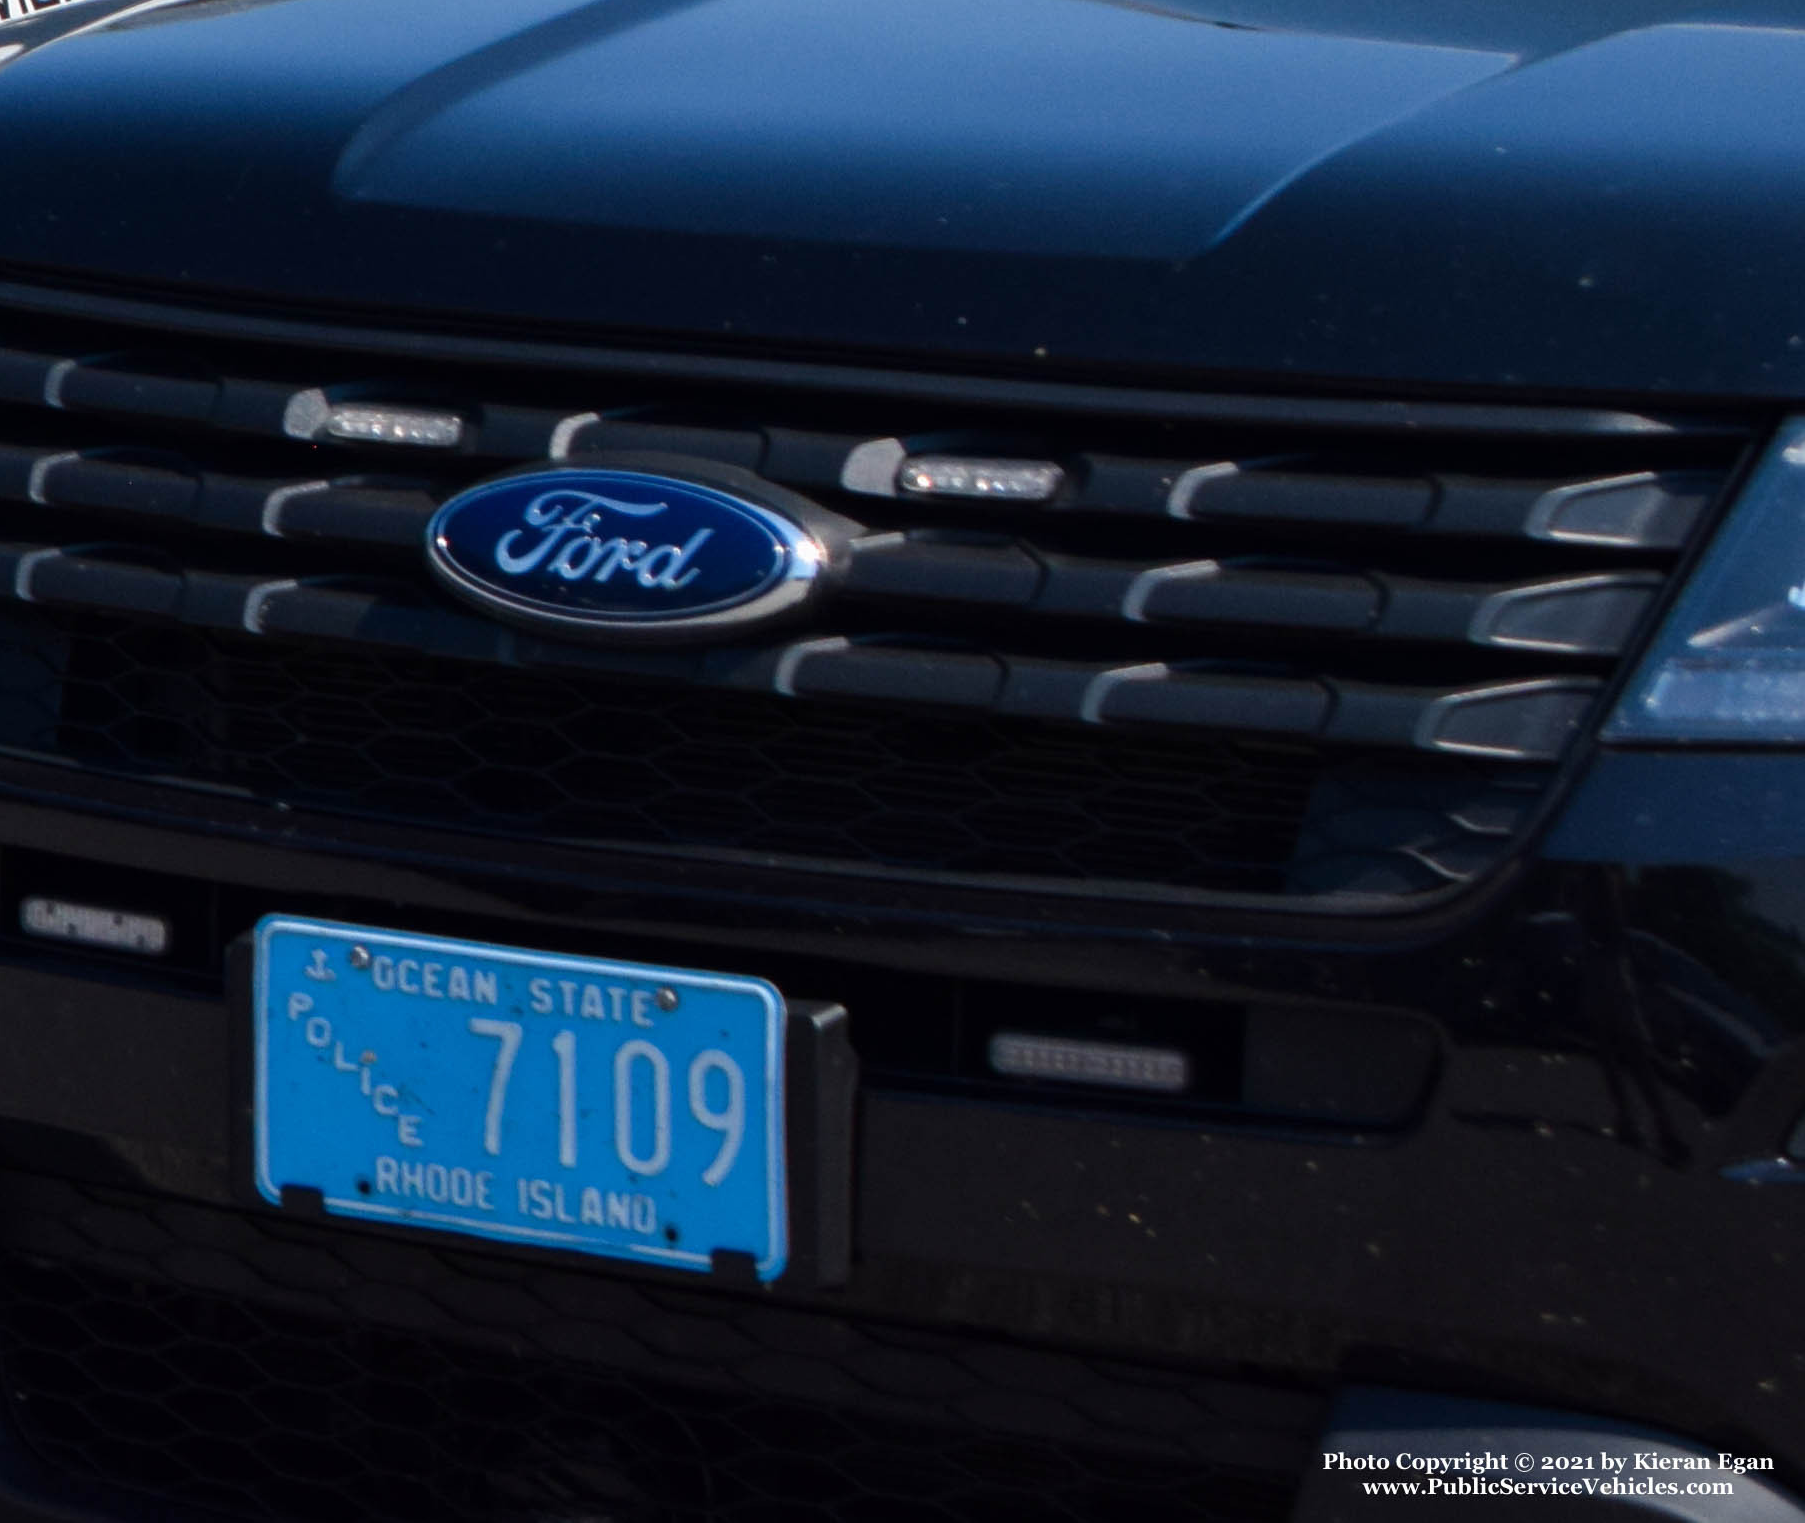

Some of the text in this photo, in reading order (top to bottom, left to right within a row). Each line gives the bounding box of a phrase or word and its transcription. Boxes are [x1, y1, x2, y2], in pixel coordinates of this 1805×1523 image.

[494, 488, 715, 591] Ford
[369, 955, 656, 1030] OCEAN STATE
[287, 993, 425, 1149] POLICE
[468, 1017, 747, 1189] 7109
[374, 1154, 658, 1236] RHODE ISLAND
